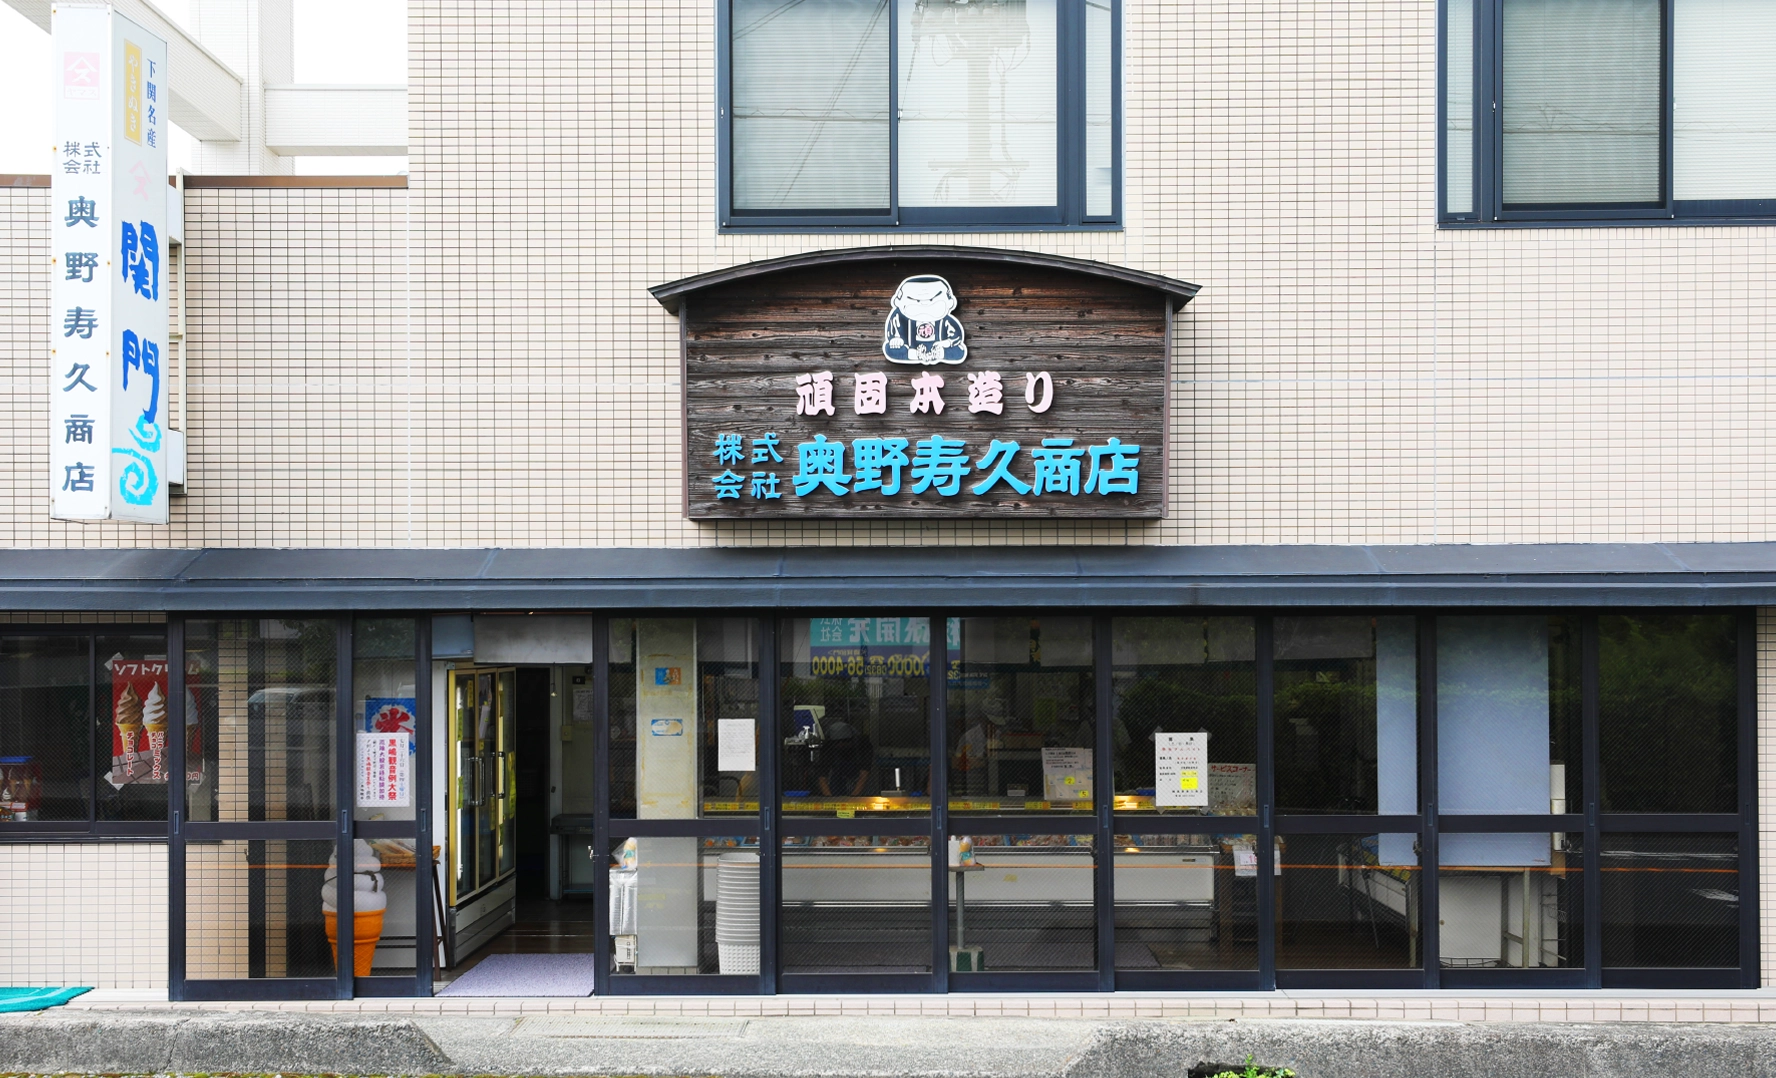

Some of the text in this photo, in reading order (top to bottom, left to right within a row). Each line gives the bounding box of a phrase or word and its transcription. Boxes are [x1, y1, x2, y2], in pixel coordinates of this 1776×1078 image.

[127, 53, 139, 133] やきぬき
[146, 57, 157, 149] 下関名産
[62, 141, 102, 158] 株式
[62, 158, 101, 175] 会社
[62, 195, 100, 493] 奥野寿久商店
[121, 219, 159, 424] 関門
[795, 370, 1054, 417] 頑固本造り
[713, 433, 784, 466] 株式
[792, 434, 1141, 497] 奥野寿久商店
[711, 469, 782, 500] 会社
[126, 731, 135, 776] チョコレート
[153, 749, 161, 779] ミックス
[1211, 764, 1251, 774] サービスコーナー
